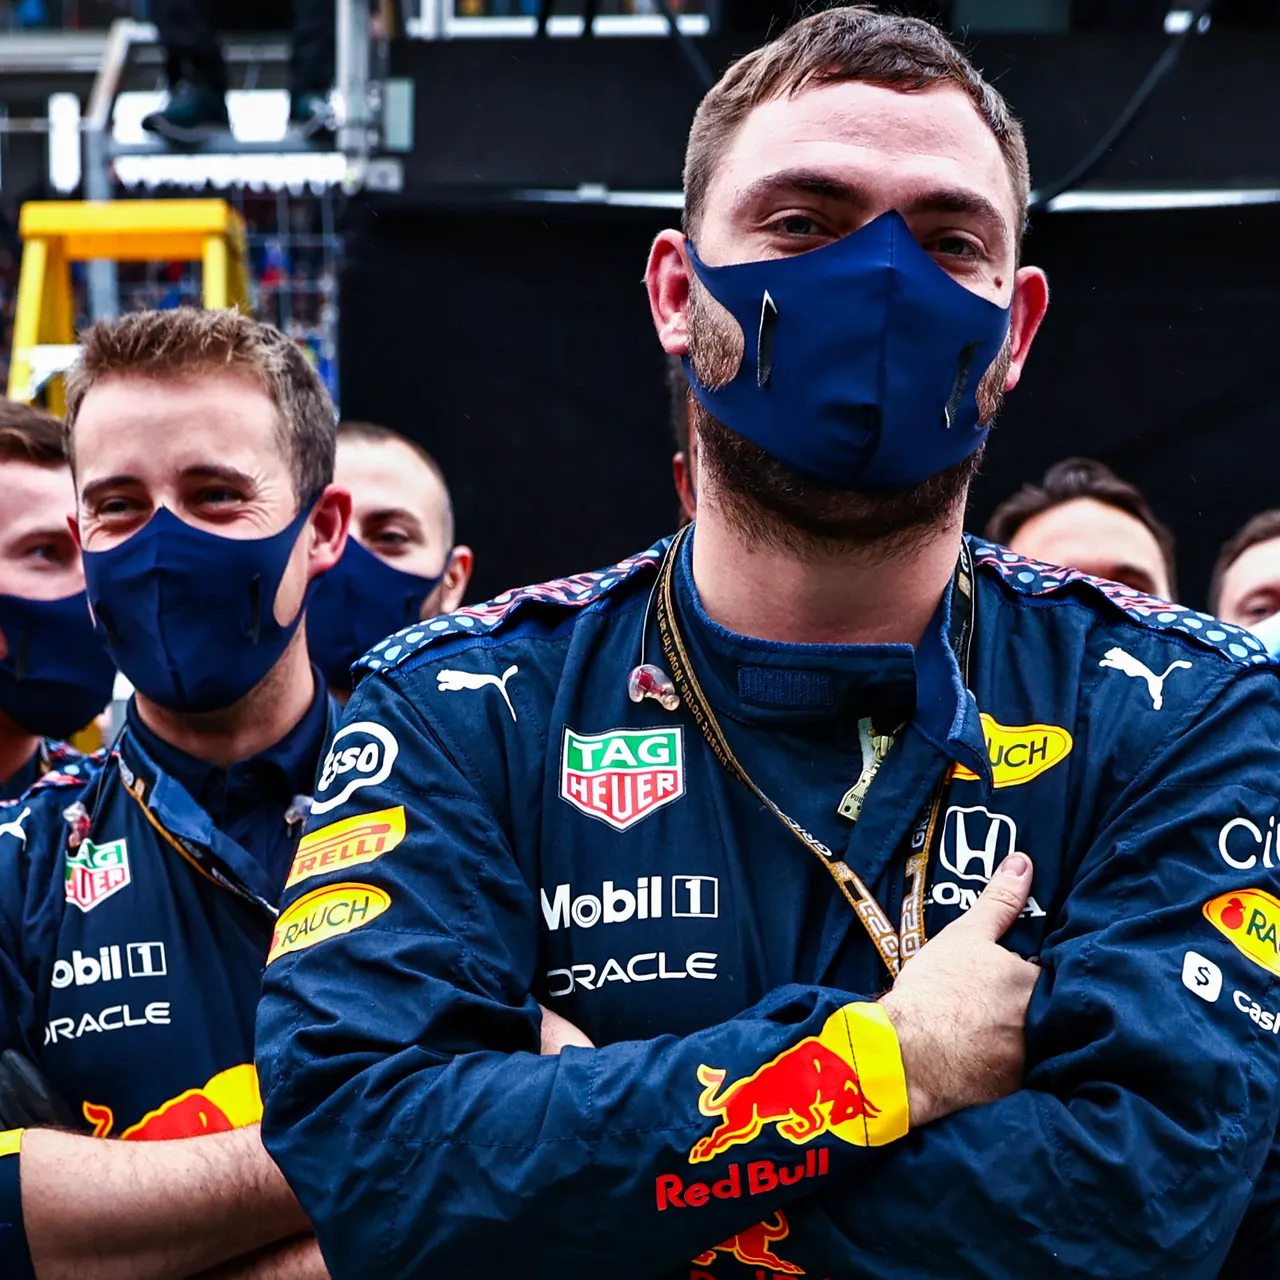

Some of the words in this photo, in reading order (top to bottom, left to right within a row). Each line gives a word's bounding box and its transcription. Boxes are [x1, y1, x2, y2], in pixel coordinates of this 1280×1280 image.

[574, 736, 670, 770] TAG
[989, 736, 1048, 769] UCH
[566, 773, 677, 823] HEUER
[297, 836, 386, 876] RELLI
[281, 895, 370, 947] RAUCH
[539, 876, 662, 931] Mobil
[51, 944, 122, 990] obil
[546, 951, 718, 997] ORACLE
[655, 1162, 742, 1213] Red
[747, 1147, 830, 1193] Bull
